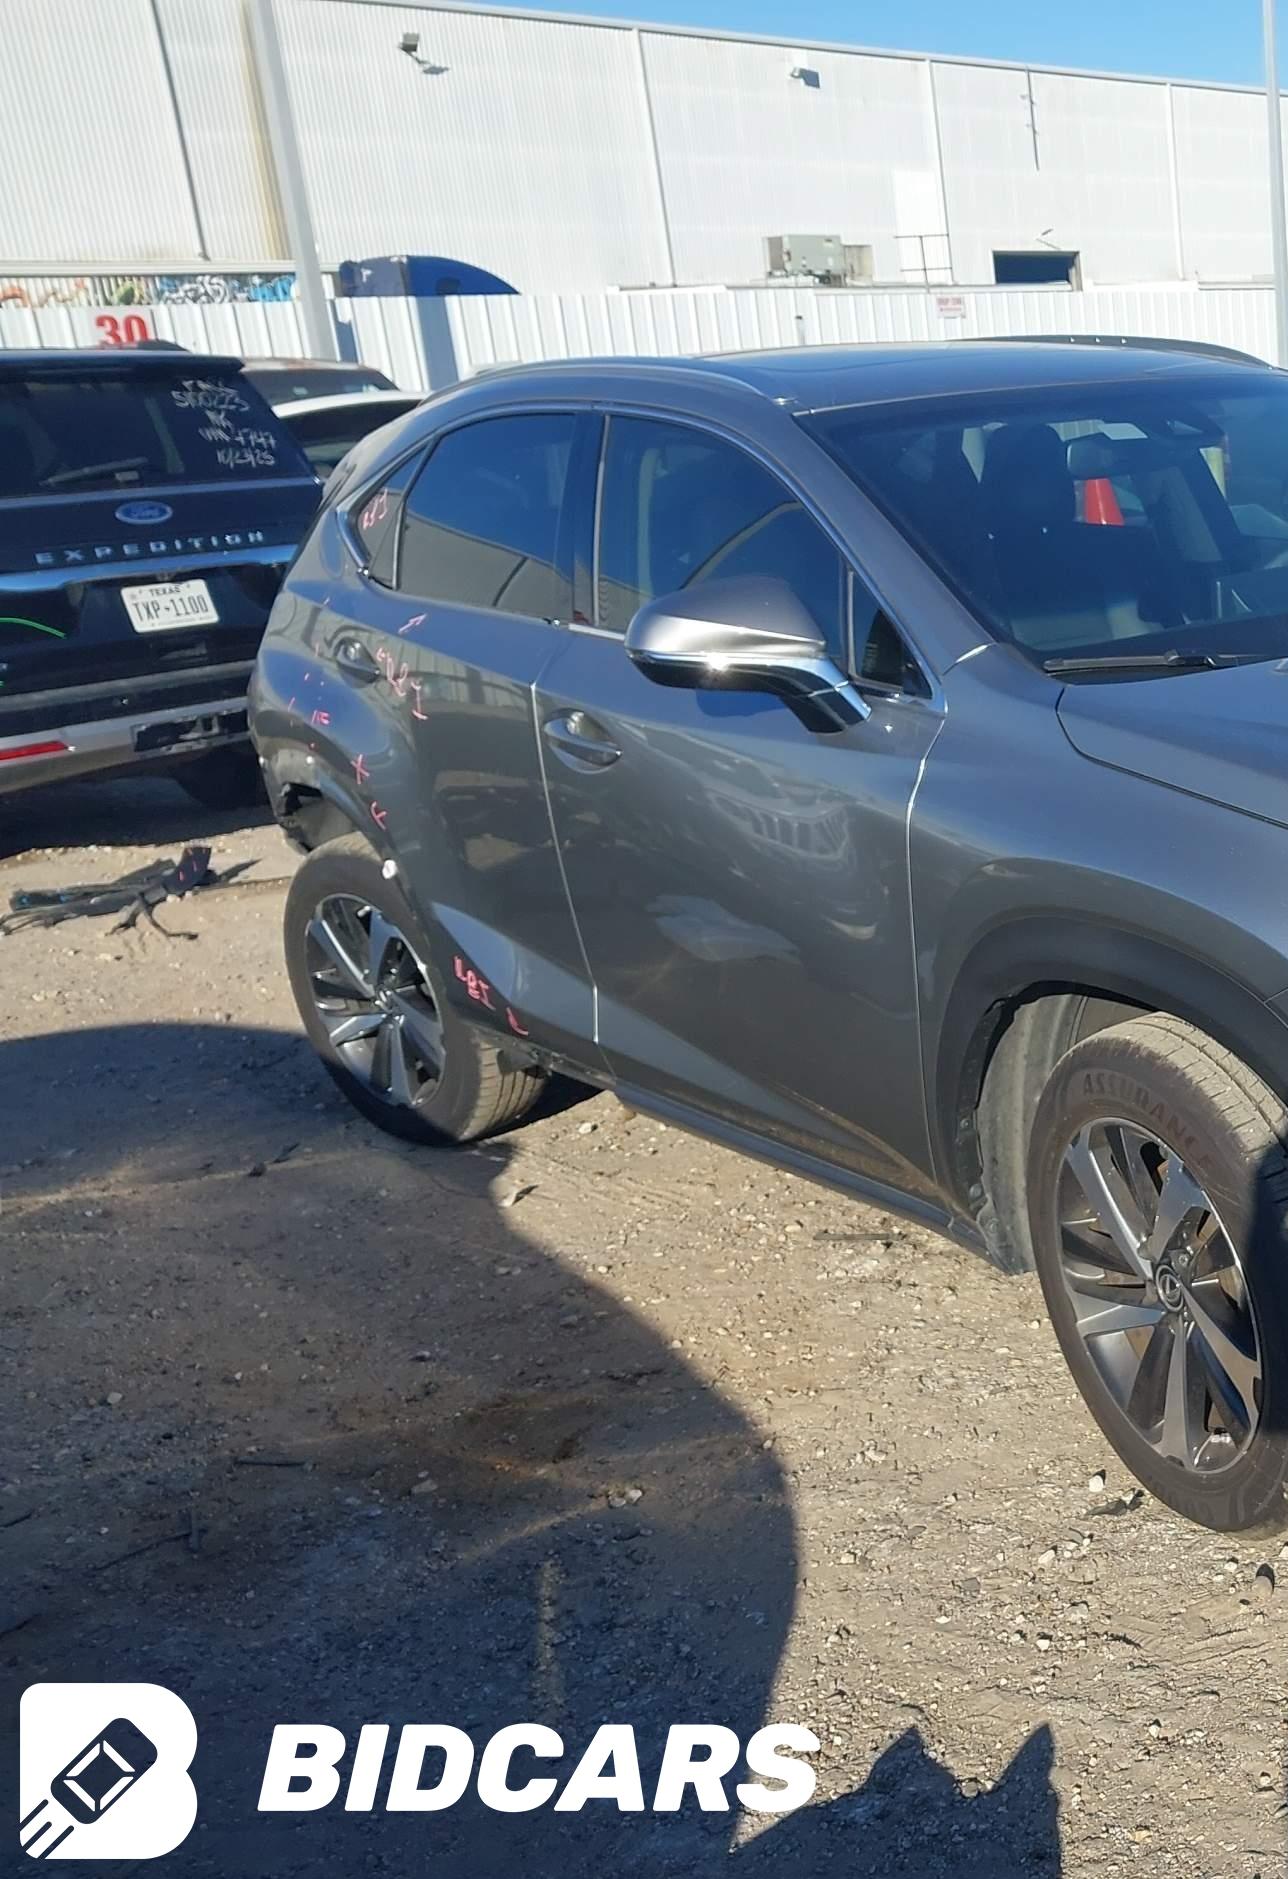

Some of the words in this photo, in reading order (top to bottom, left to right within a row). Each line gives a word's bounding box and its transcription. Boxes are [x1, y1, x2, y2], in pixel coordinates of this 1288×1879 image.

[96, 315, 149, 342] 30
[35, 530, 264, 565] EXPEDITION
[148, 585, 181, 597] TEXAS
